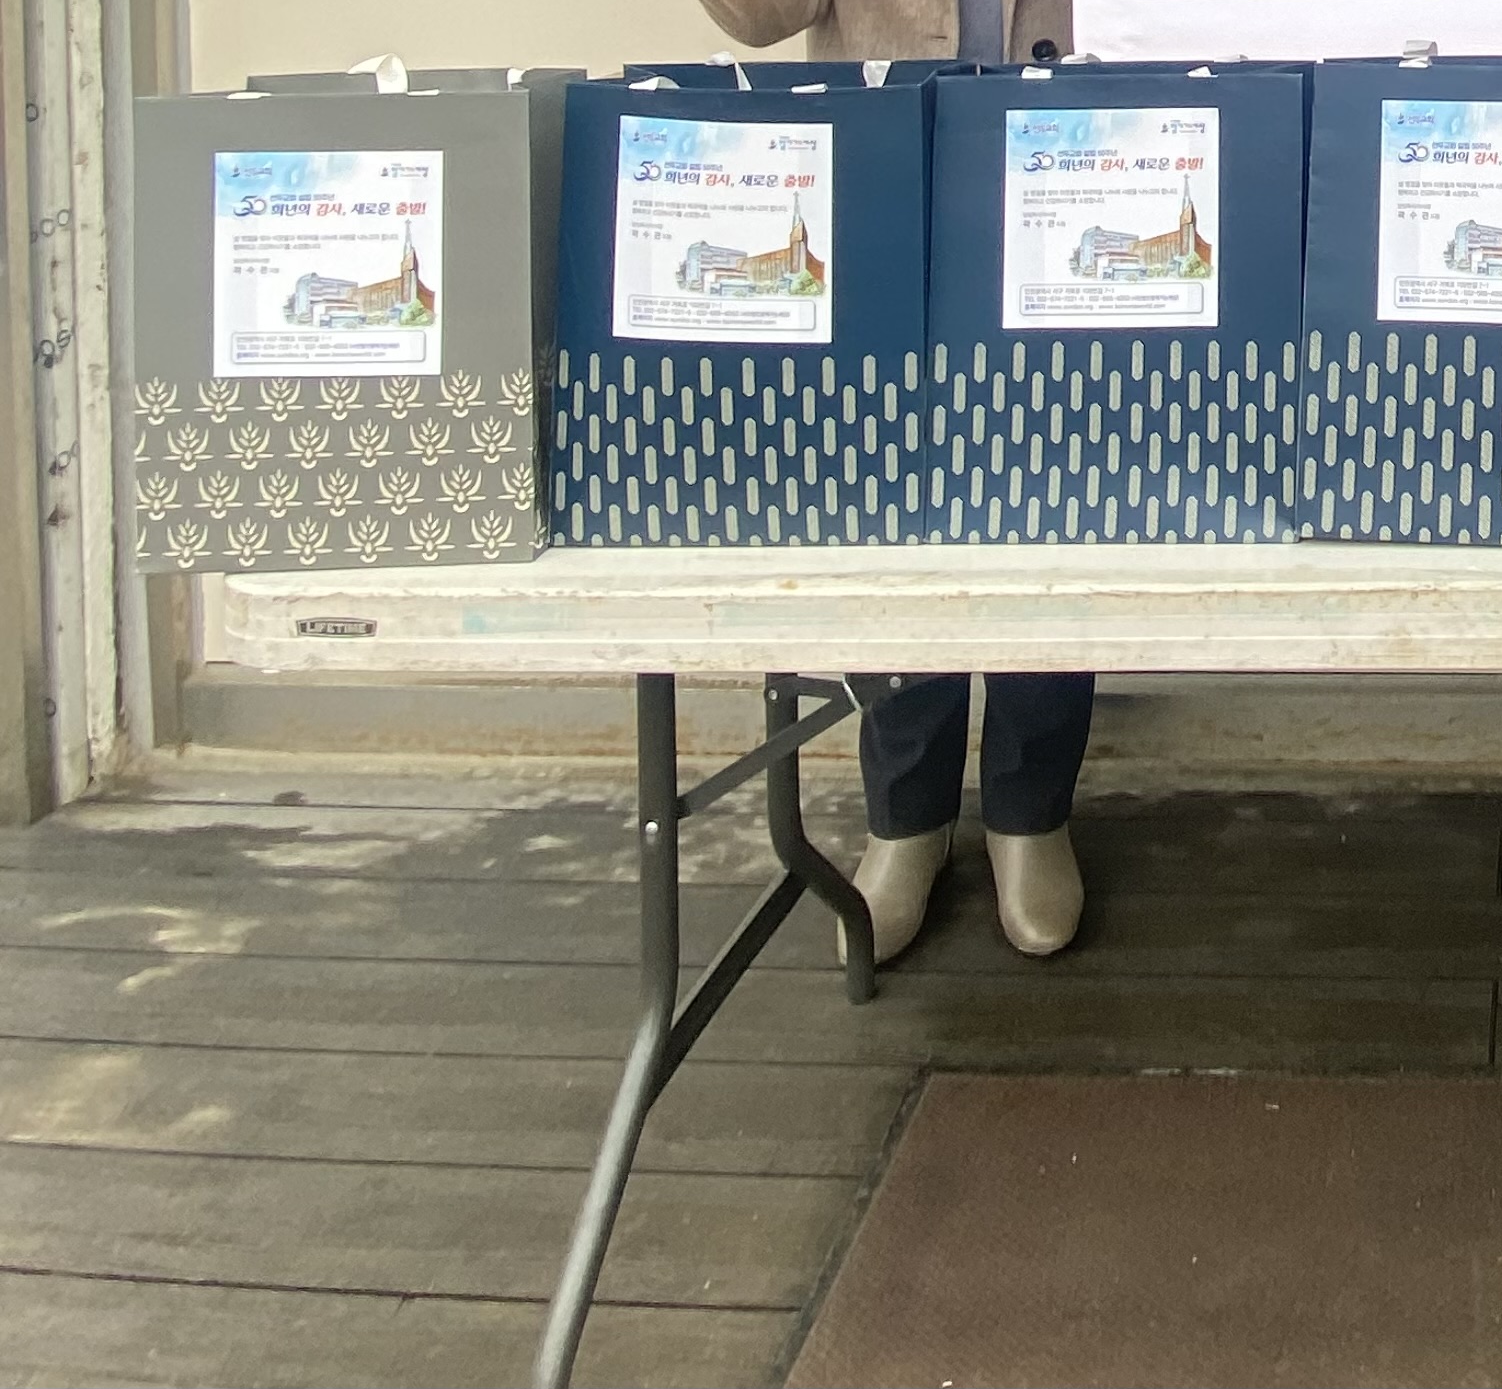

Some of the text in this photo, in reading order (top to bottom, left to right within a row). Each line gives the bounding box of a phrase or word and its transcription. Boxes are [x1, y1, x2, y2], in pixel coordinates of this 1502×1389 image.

[1132, 158, 1170, 171] 새로운
[738, 174, 778, 187] 새로운
[350, 202, 391, 216] 새로운
